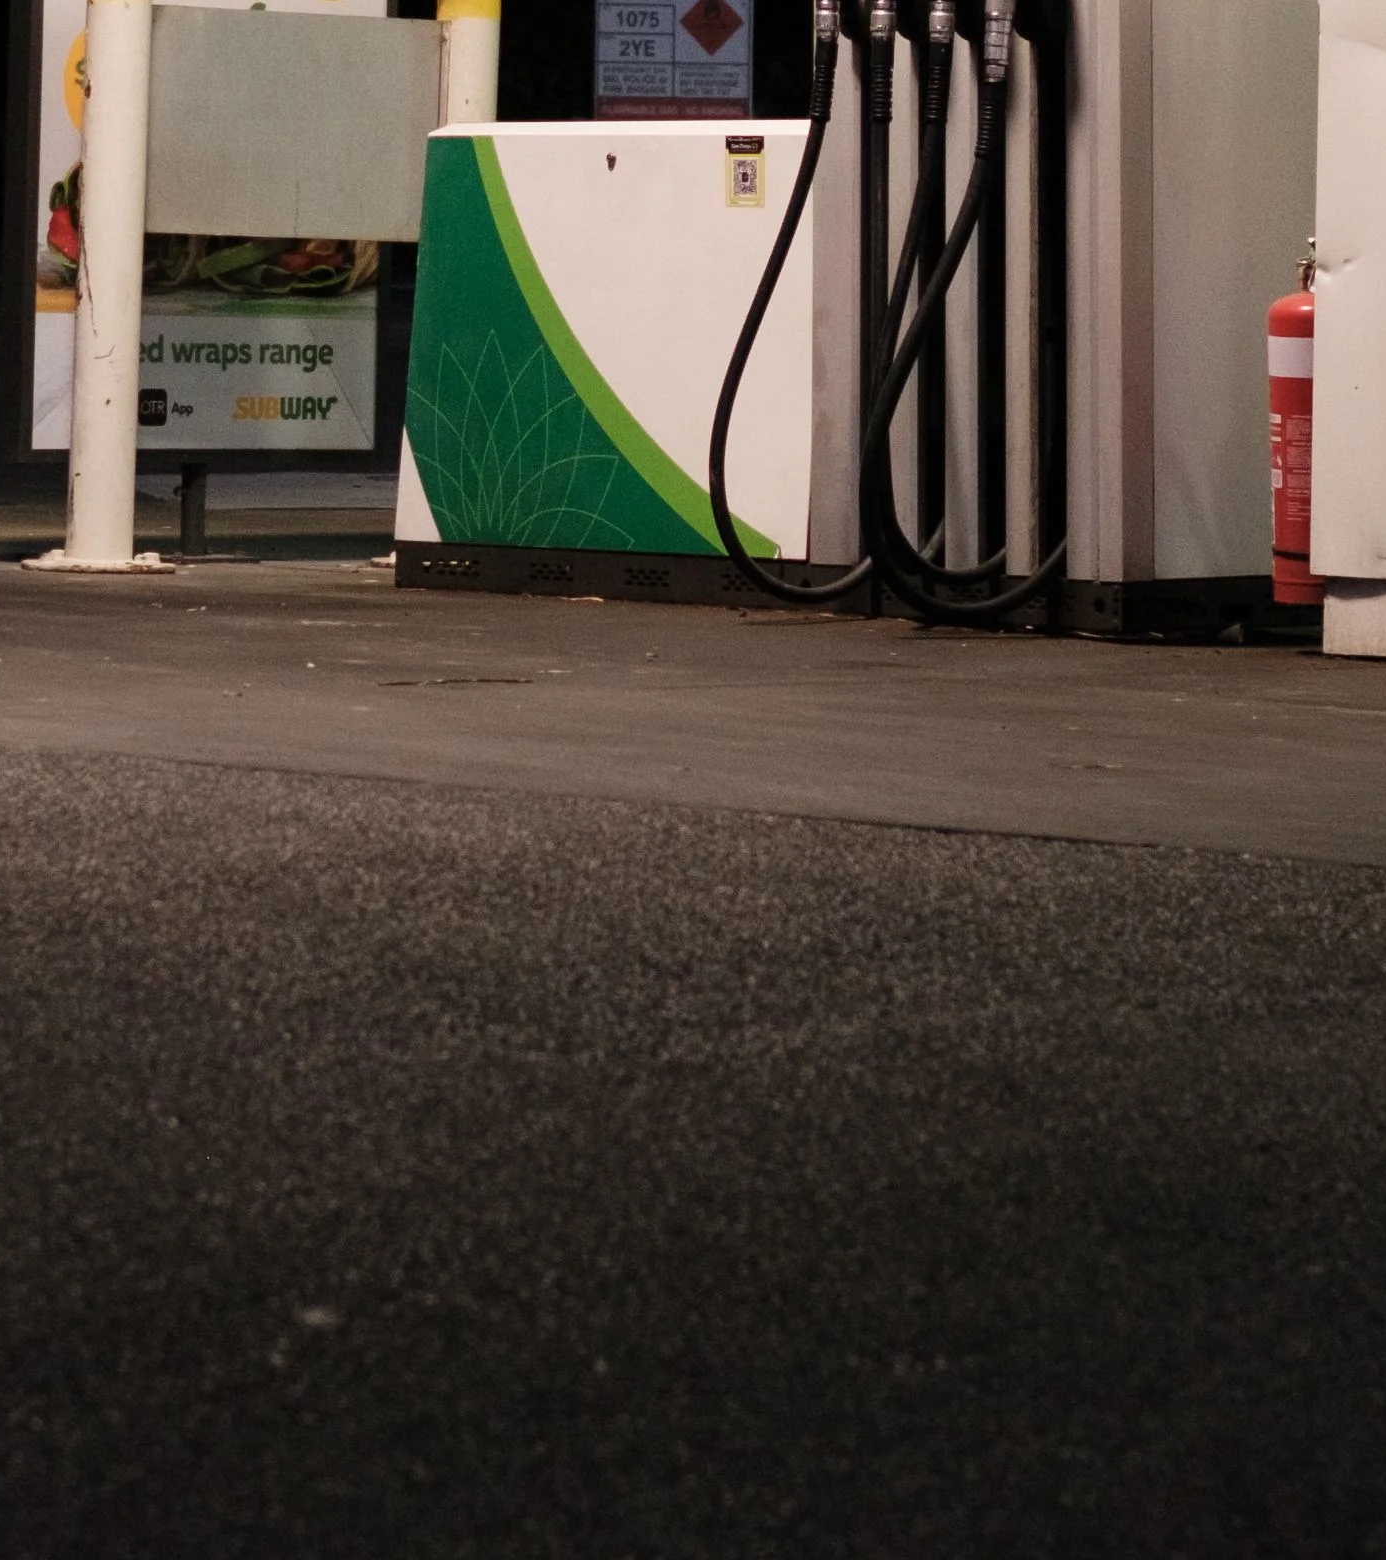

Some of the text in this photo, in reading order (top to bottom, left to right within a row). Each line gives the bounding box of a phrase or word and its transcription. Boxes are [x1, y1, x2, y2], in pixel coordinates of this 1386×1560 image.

[617, 11, 661, 29] 1075
[619, 40, 657, 58] 2YE
[171, 342, 253, 372] wraps
[259, 342, 335, 374] range
[171, 401, 194, 417] App
[233, 395, 339, 423] SUBWAY
